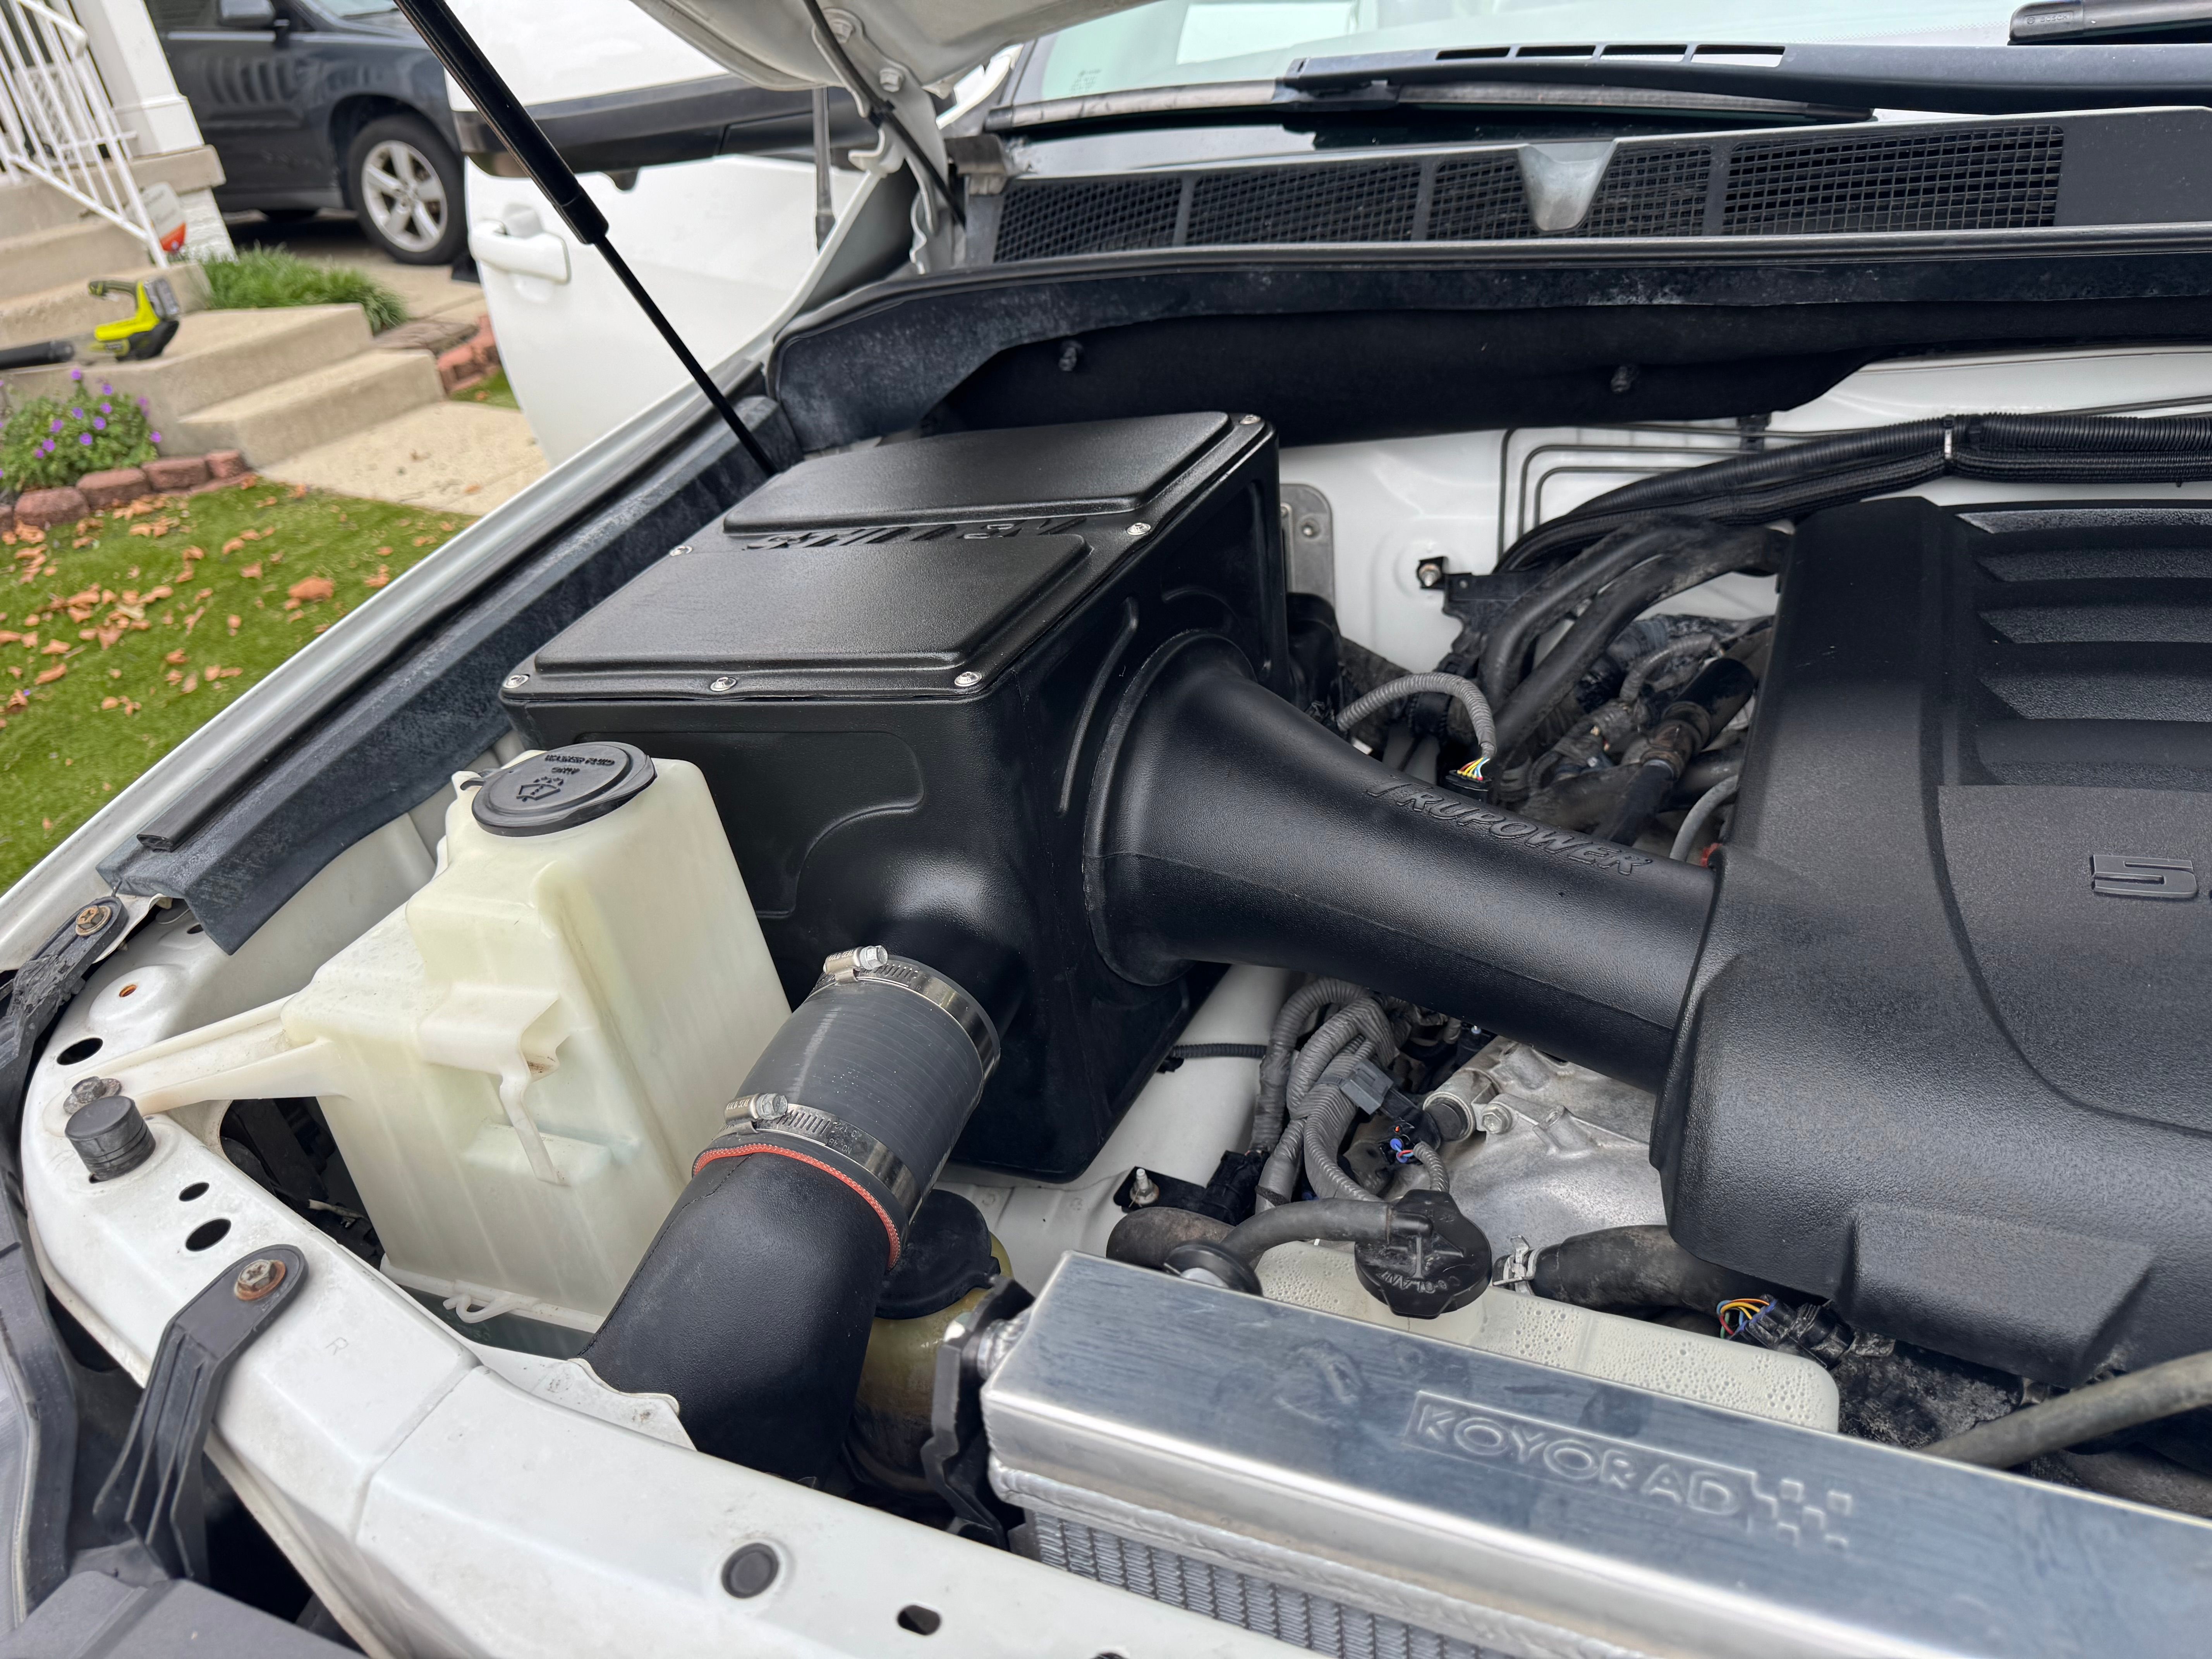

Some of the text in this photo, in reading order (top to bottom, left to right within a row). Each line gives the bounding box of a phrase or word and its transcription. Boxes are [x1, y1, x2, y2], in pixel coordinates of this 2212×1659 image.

[1366, 775, 1653, 876] TRUPOWER
[1376, 1270, 1461, 1294] COOLANT
[325, 1337, 349, 1355] R
[1417, 1404, 1743, 1515] KOYORAD
